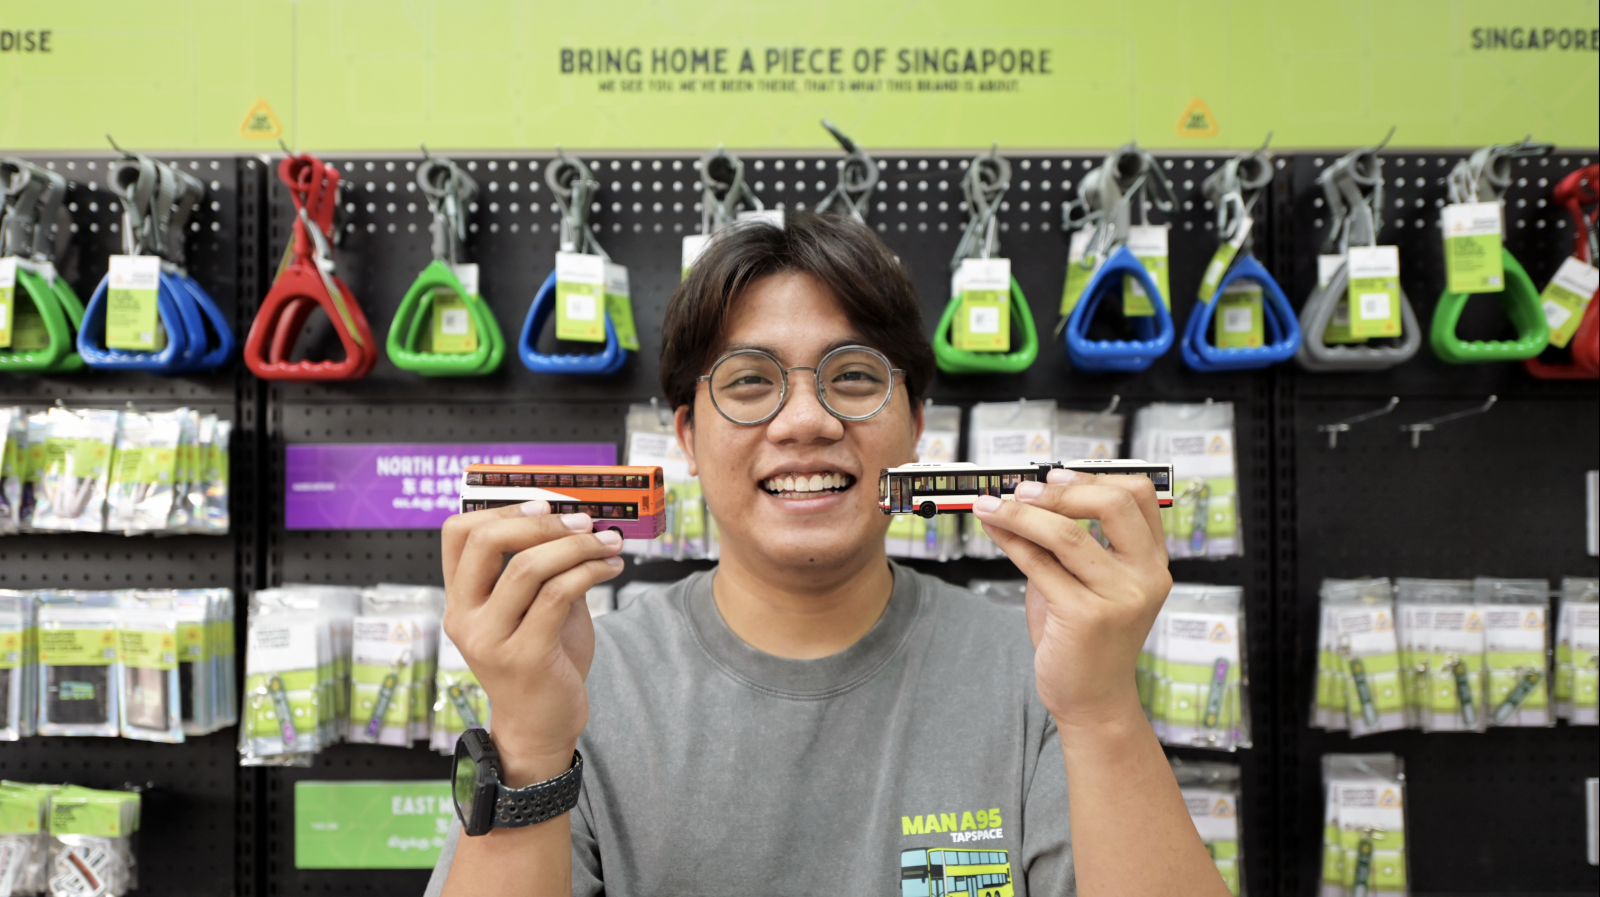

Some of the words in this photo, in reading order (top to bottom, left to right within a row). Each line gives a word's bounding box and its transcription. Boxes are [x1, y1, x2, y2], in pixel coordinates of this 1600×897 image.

[0, 30, 52, 53] DISE
[1471, 27, 1599, 51] SINGAPORE
[560, 48, 642, 74] BRING
[651, 48, 728, 74] HOME
[738, 48, 756, 74] A
[766, 48, 843, 74] PIECE
[853, 48, 887, 74] OF
[897, 48, 1053, 74] SINGAPORE
[377, 456, 434, 476] NORTH
[392, 796, 434, 815] EAST
[901, 812, 958, 835] MAN
[960, 808, 1002, 831] A95
[950, 828, 1004, 843] TAPSPACE
